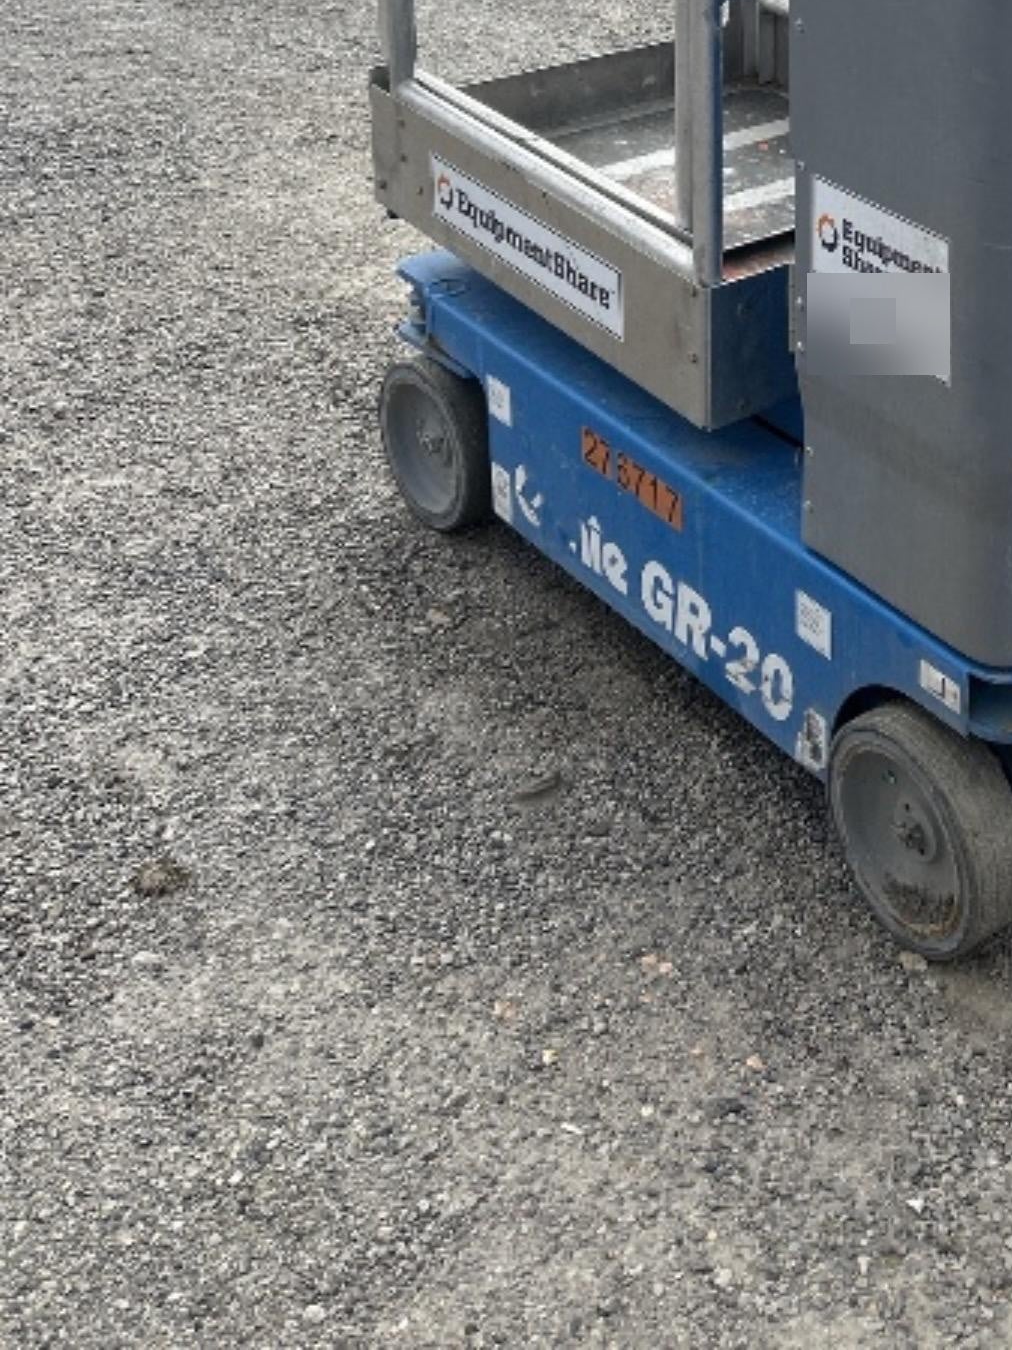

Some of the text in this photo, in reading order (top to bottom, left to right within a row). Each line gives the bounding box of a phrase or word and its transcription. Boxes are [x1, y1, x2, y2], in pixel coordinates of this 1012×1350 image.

[457, 189, 610, 309] EquipmentShare
[584, 430, 679, 523] 276717
[641, 560, 794, 721] GR-20
